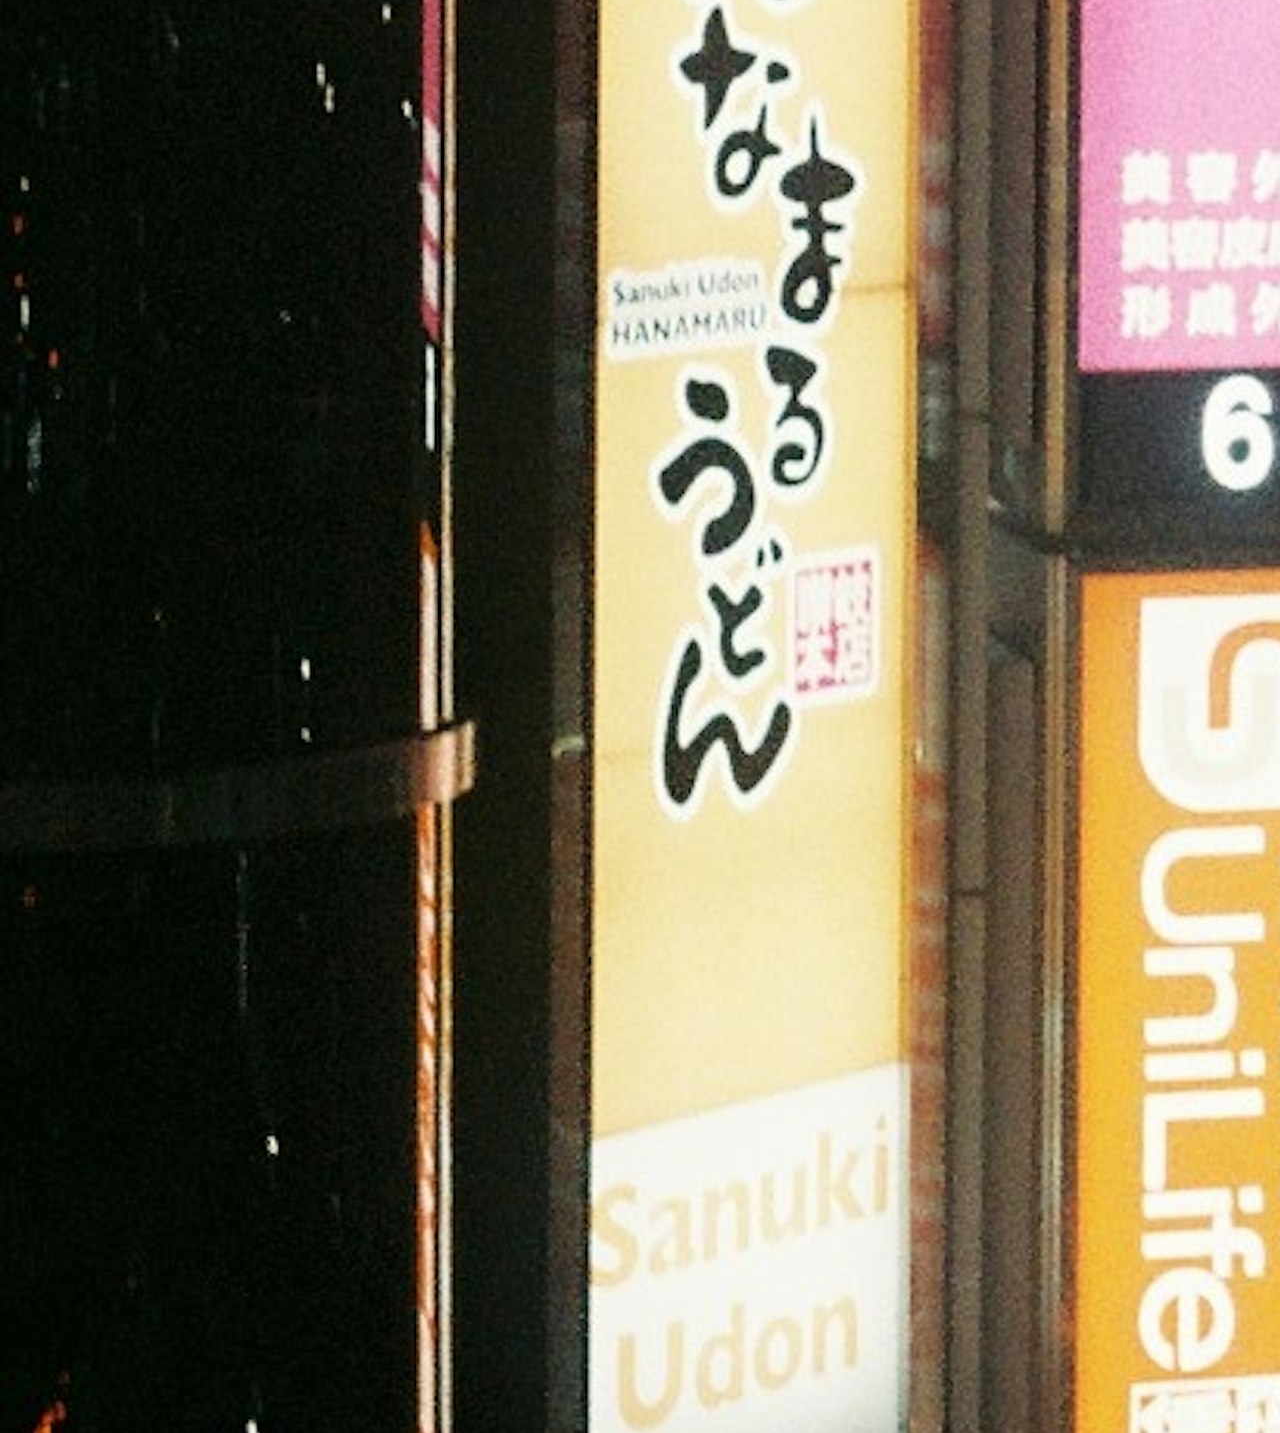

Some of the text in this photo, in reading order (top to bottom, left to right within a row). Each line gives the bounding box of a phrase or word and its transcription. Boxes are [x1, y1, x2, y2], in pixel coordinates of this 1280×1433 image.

[613, 269, 758, 305] Sanuki Udon
[613, 304, 767, 344] HANAMARU
[1201, 374, 1276, 492] 6
[590, 1115, 890, 1287] Sanuki
[616, 1295, 859, 1433] Udon
